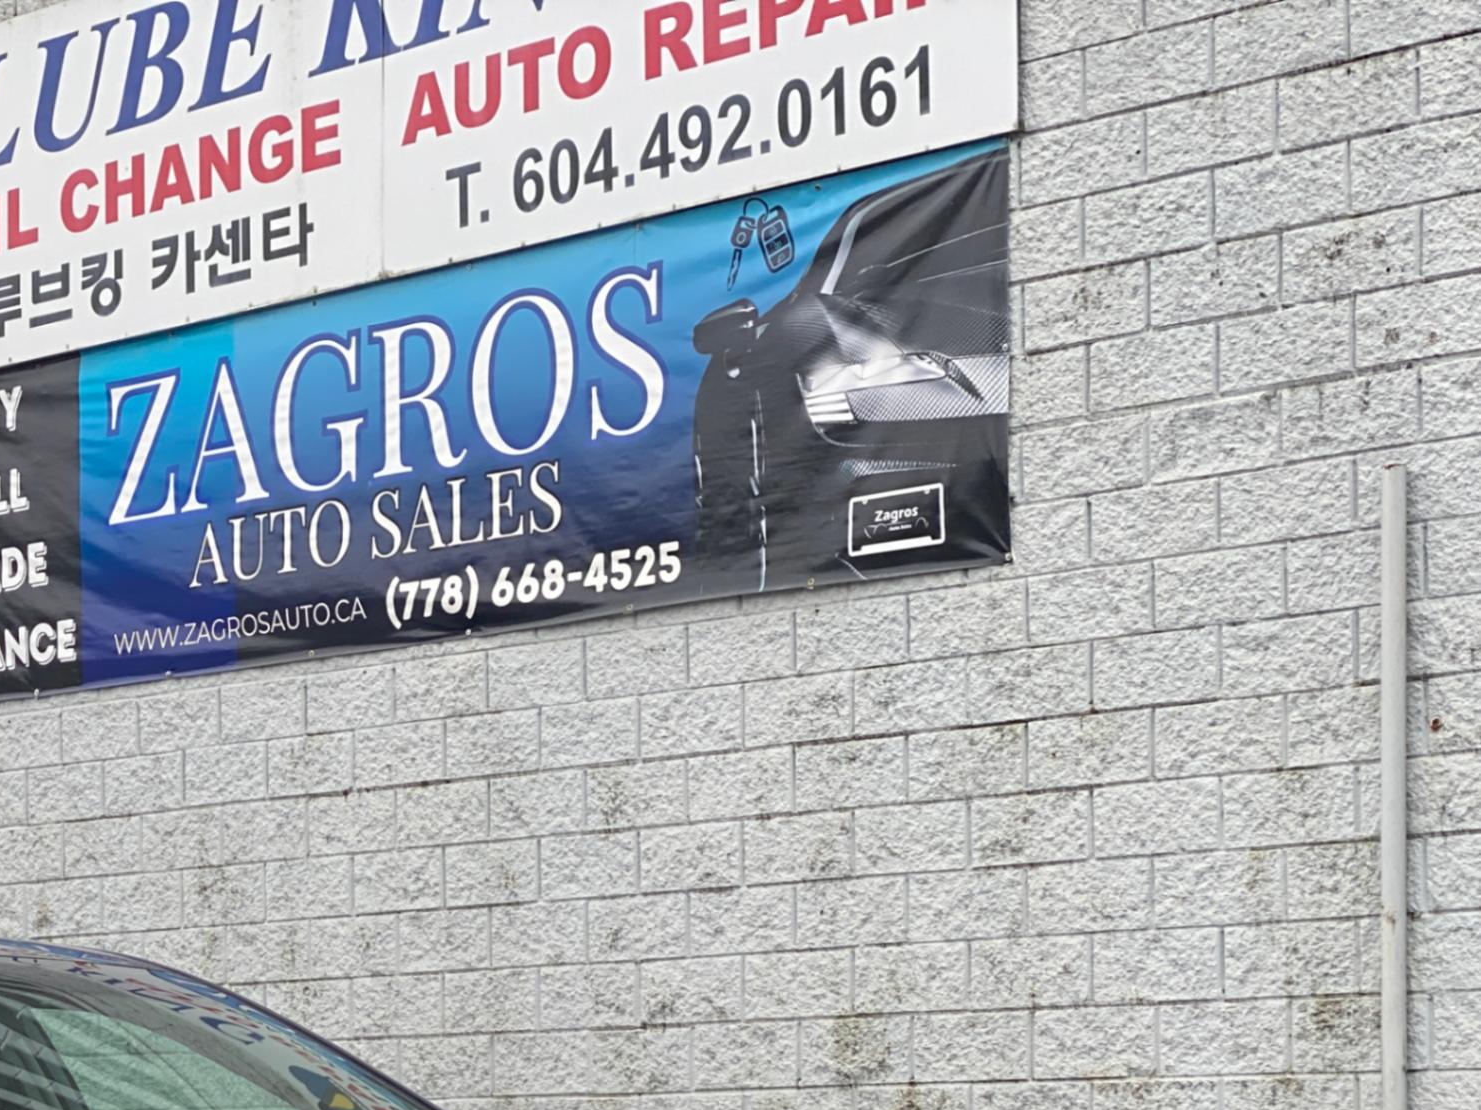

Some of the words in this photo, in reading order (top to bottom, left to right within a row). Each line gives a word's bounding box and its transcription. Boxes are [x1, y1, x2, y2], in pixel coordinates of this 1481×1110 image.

[400, 24, 612, 147] AUTO
[445, 161, 490, 229] T.
[512, 44, 932, 213] 604.492.0161
[60, 99, 341, 234] CHANGE
[151, 202, 314, 295] 카센타
[107, 266, 666, 526] ZAGROS
[188, 498, 351, 588] AUTO
[370, 460, 563, 559] SALES
[874, 506, 919, 524] Zagros
[114, 597, 367, 655] WWW.ZAGROSAUTO.CA
[385, 565, 480, 630] (778)
[490, 540, 682, 609] 668-4525
